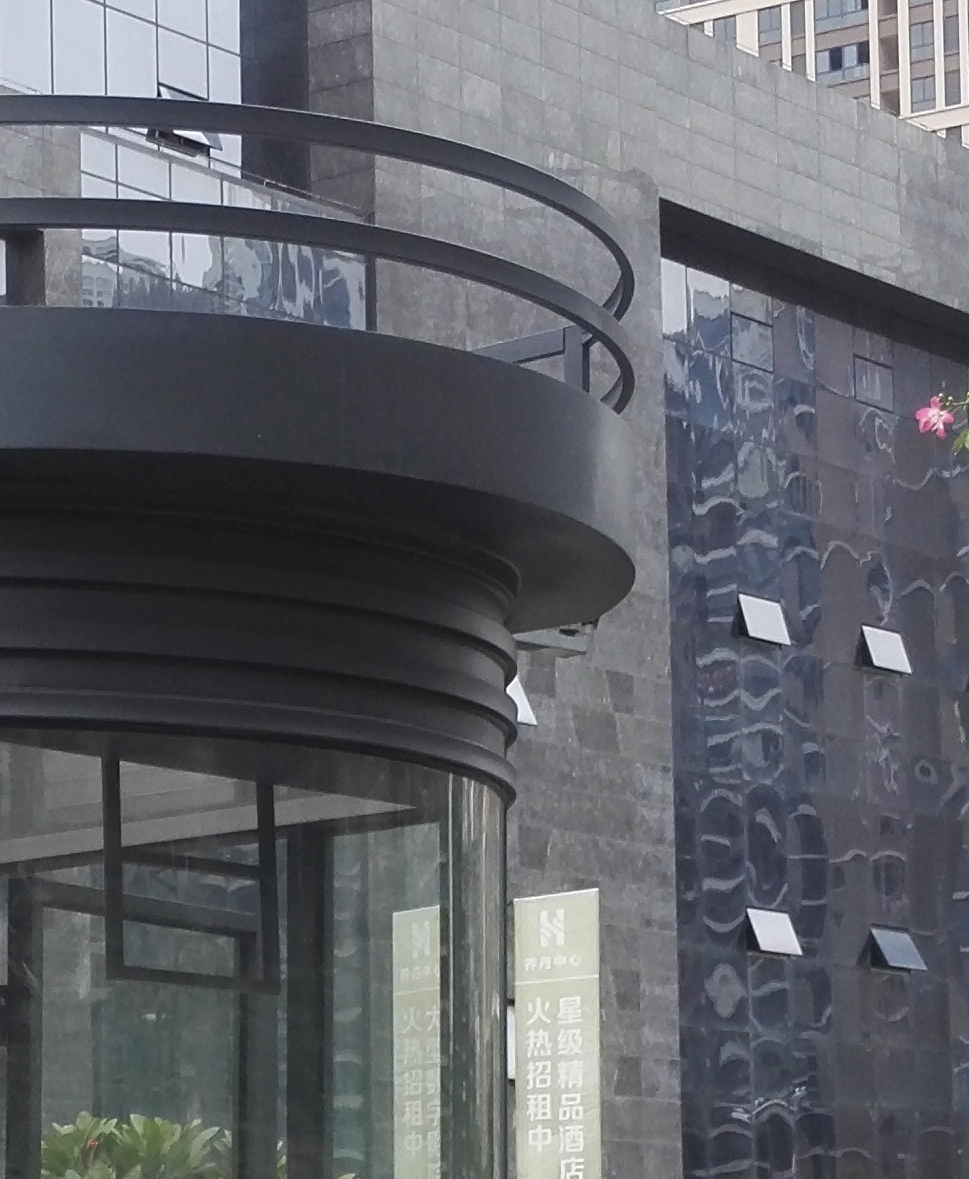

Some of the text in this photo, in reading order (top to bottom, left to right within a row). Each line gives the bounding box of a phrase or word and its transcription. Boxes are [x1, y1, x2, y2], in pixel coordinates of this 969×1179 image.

[525, 996, 552, 1154] 火热招租中
